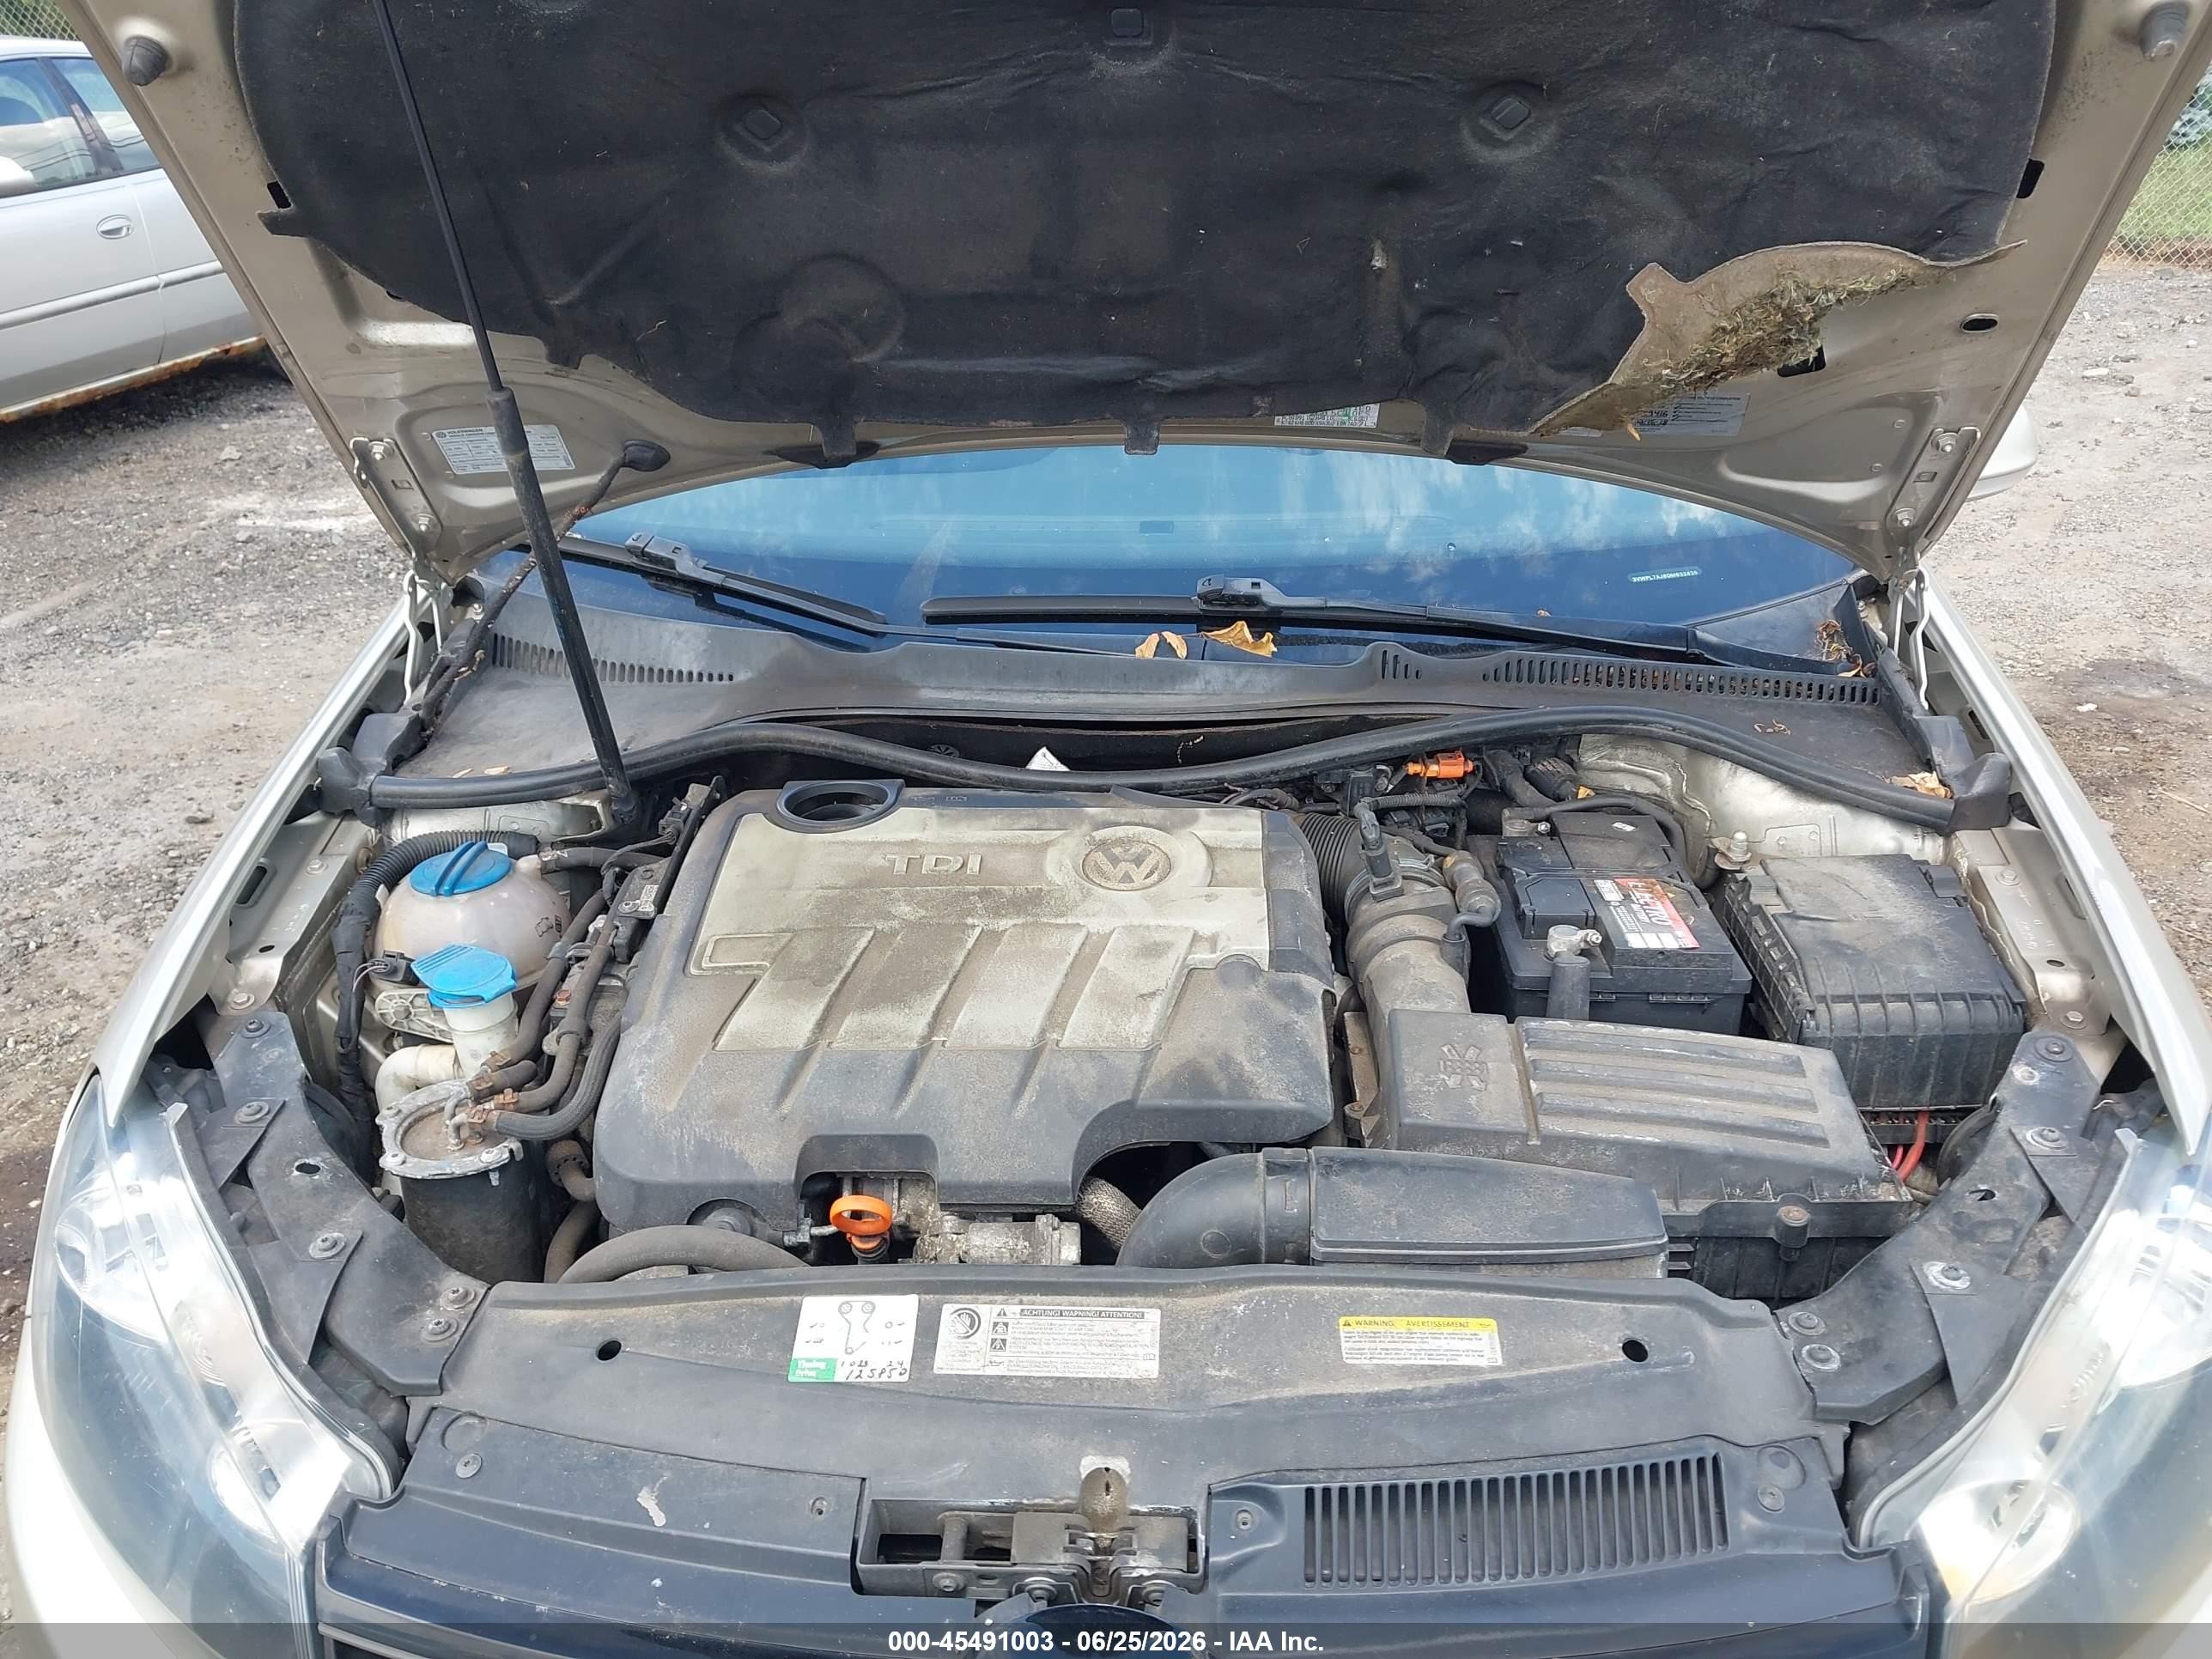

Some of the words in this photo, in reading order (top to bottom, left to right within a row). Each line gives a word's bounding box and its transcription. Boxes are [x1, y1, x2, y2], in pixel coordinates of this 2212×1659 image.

[885, 854, 982, 876] TDI
[1061, 1310, 1100, 1318] WARNING!
[1101, 1310, 1143, 1319] ATTENTION!
[1405, 1320, 1471, 1328] AVERTISSEMENT
